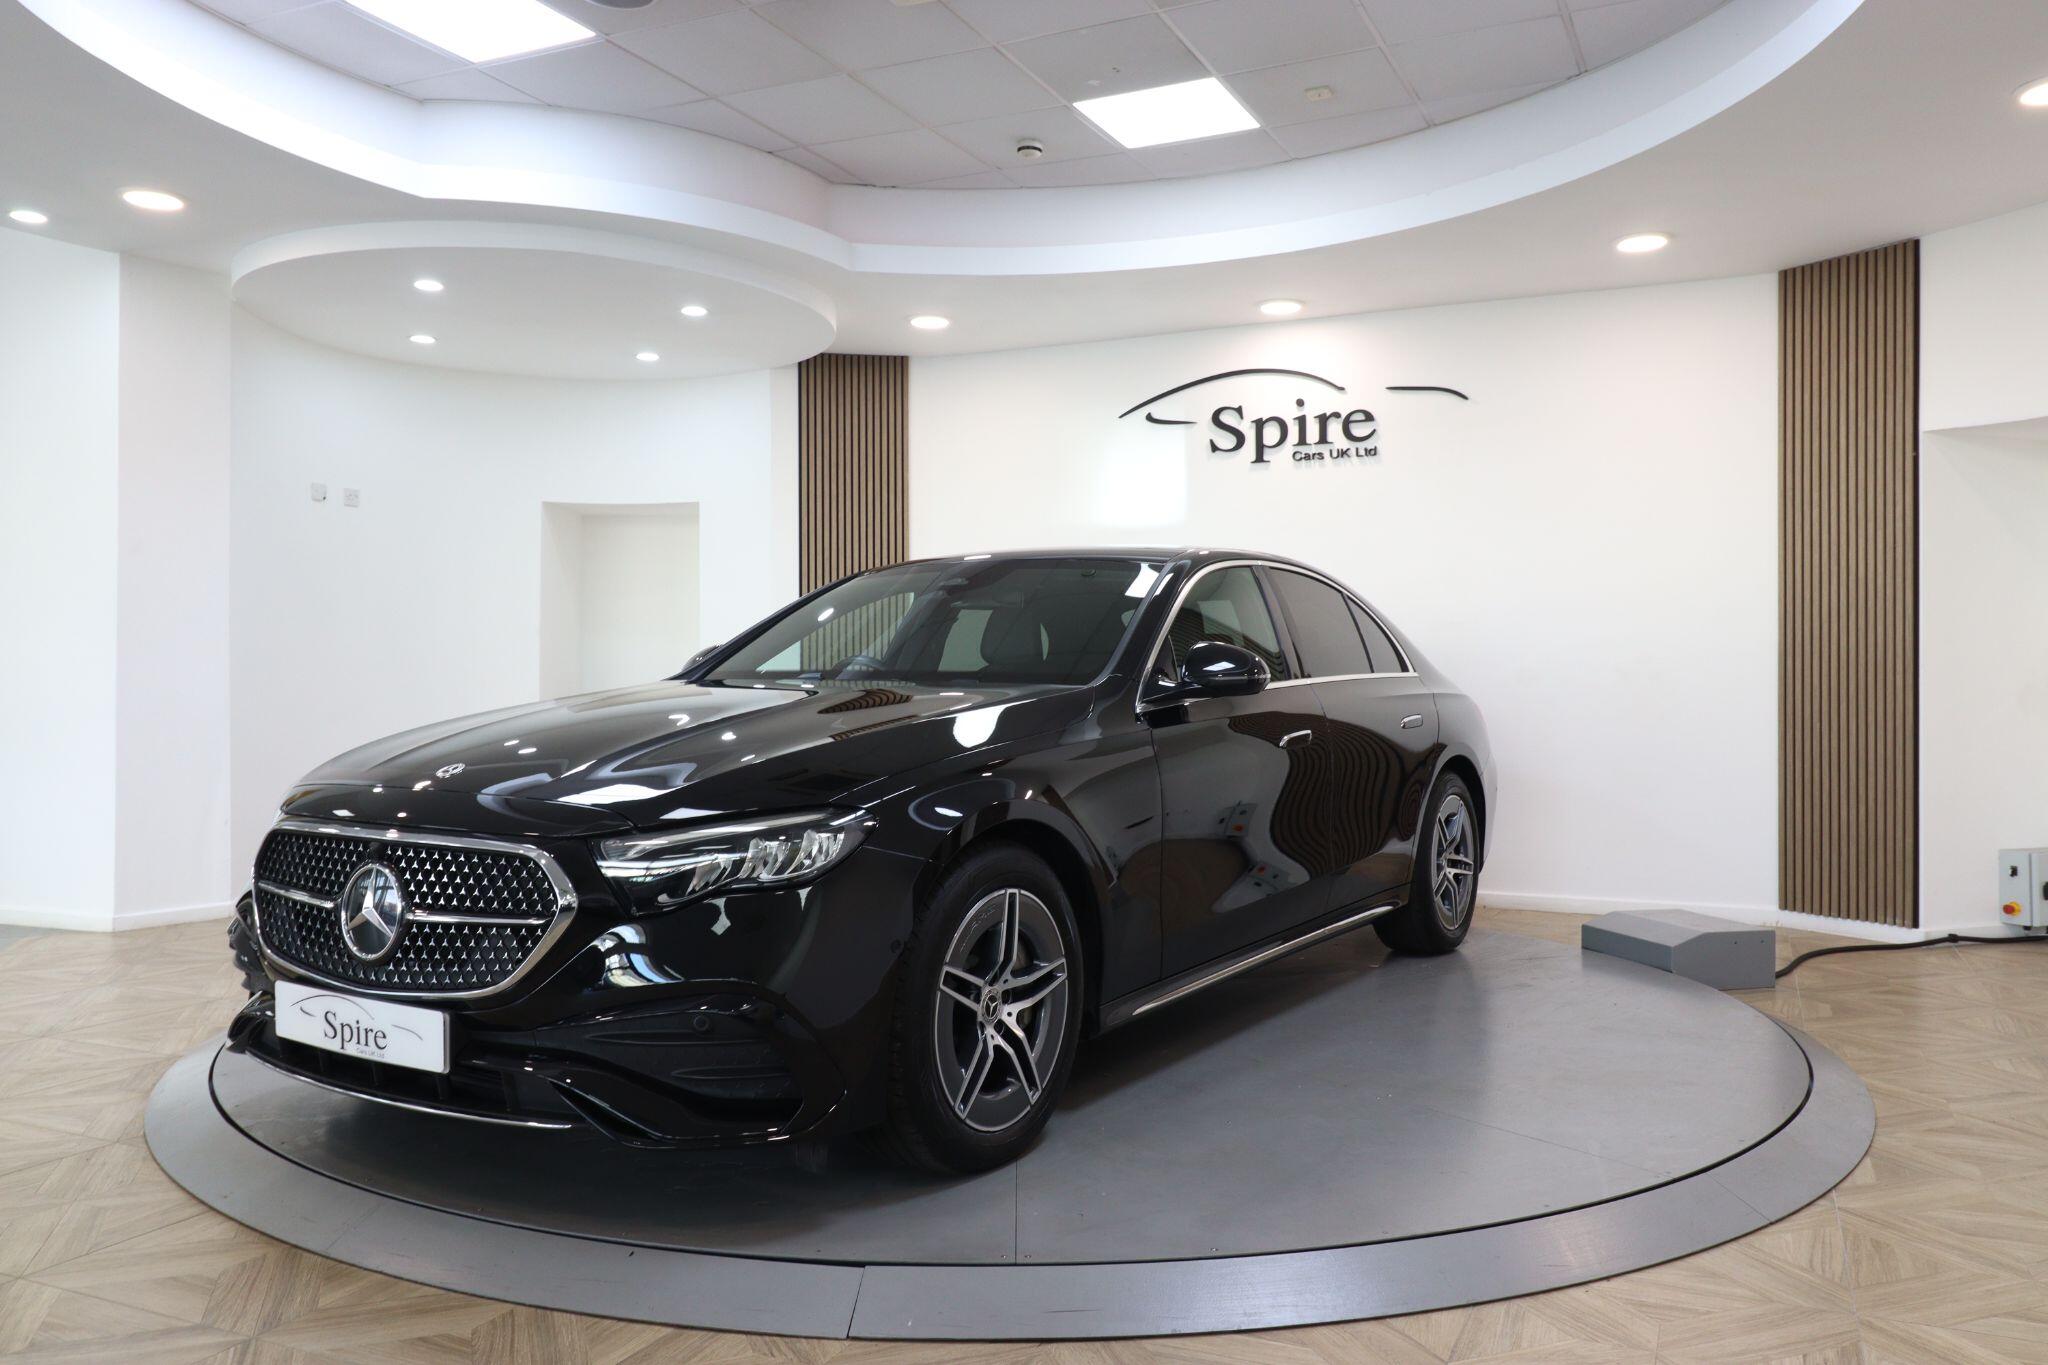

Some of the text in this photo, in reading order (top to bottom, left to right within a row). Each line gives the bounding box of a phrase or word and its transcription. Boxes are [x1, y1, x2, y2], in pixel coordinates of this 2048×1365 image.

[1209, 397, 1376, 464] Spire
[1292, 446, 1377, 462] Cars UK Ltd
[324, 1010, 387, 1050] Spire
